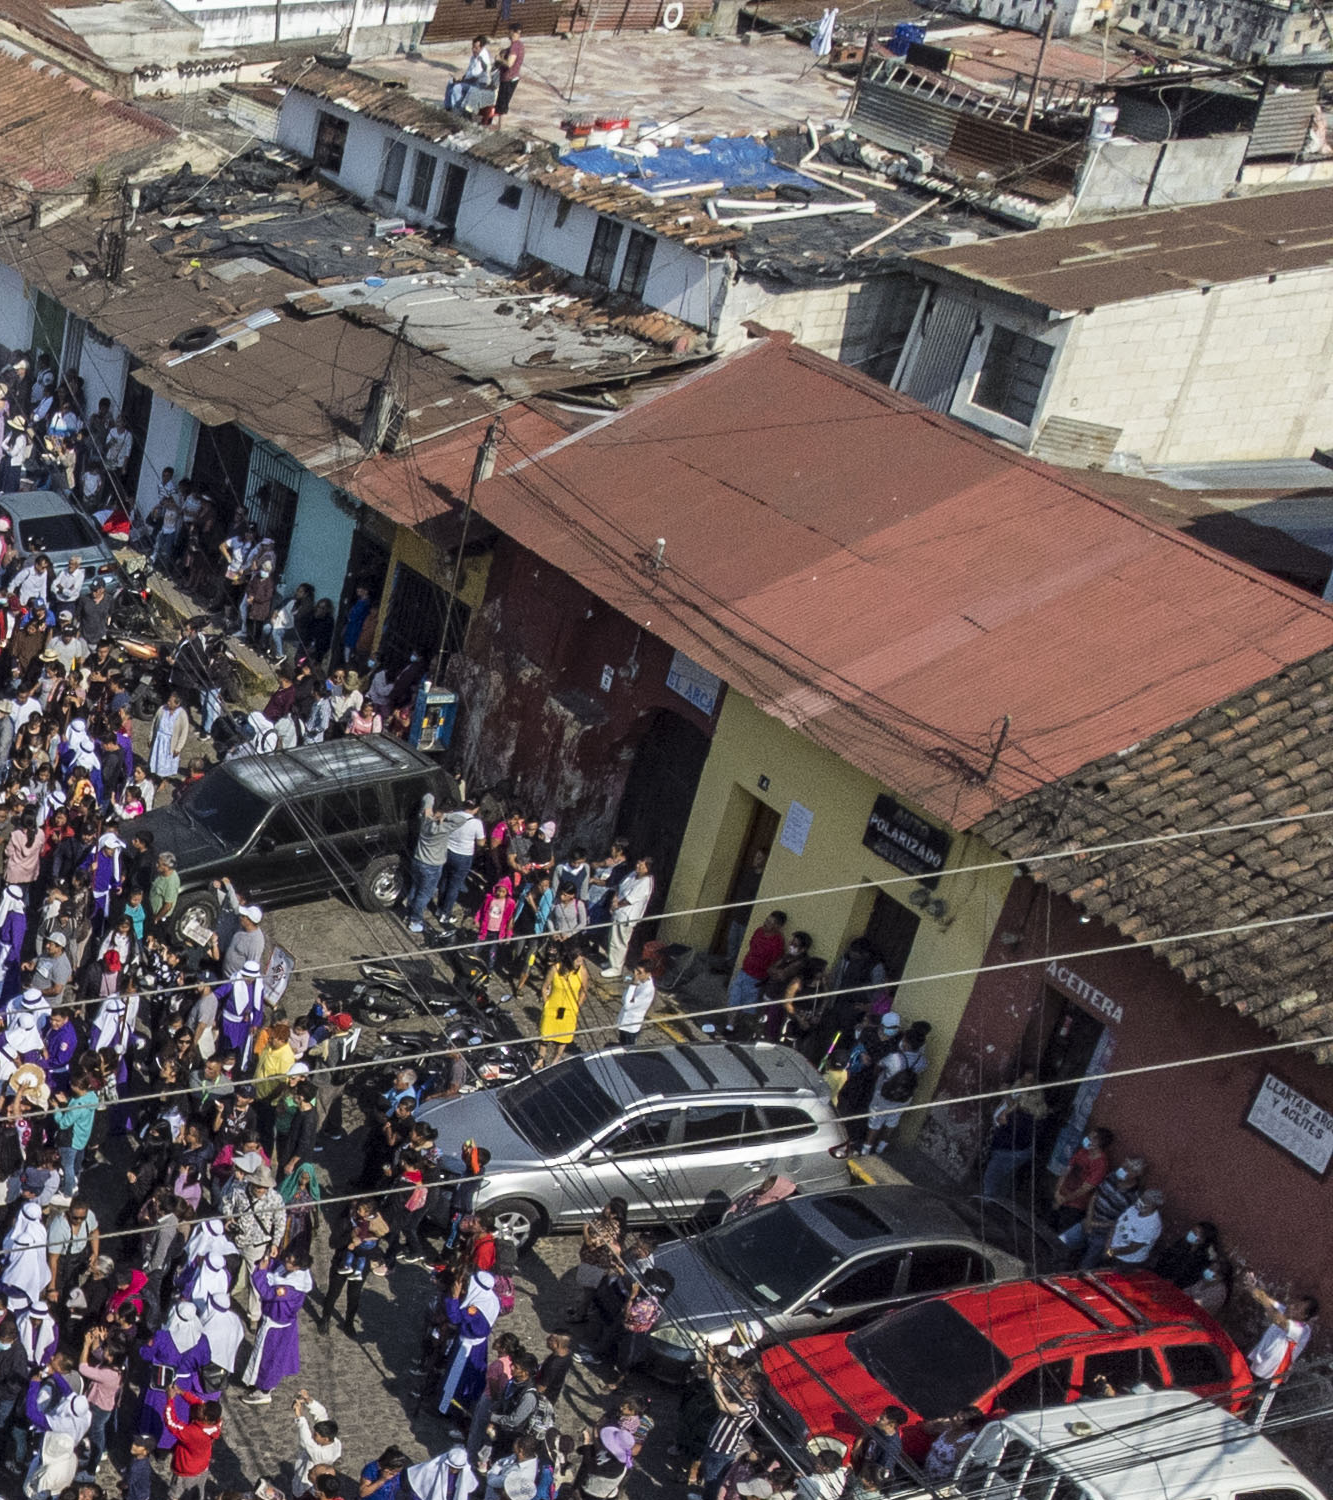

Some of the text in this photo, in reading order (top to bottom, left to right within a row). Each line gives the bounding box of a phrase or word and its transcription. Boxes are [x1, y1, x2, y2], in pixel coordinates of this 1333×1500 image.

[869, 813, 942, 867] POLARIZADO
[1046, 960, 1123, 1024] ACEITERA
[1266, 1077, 1312, 1114] LLANTAS
[1273, 1097, 1324, 1139] Y ACEITES
